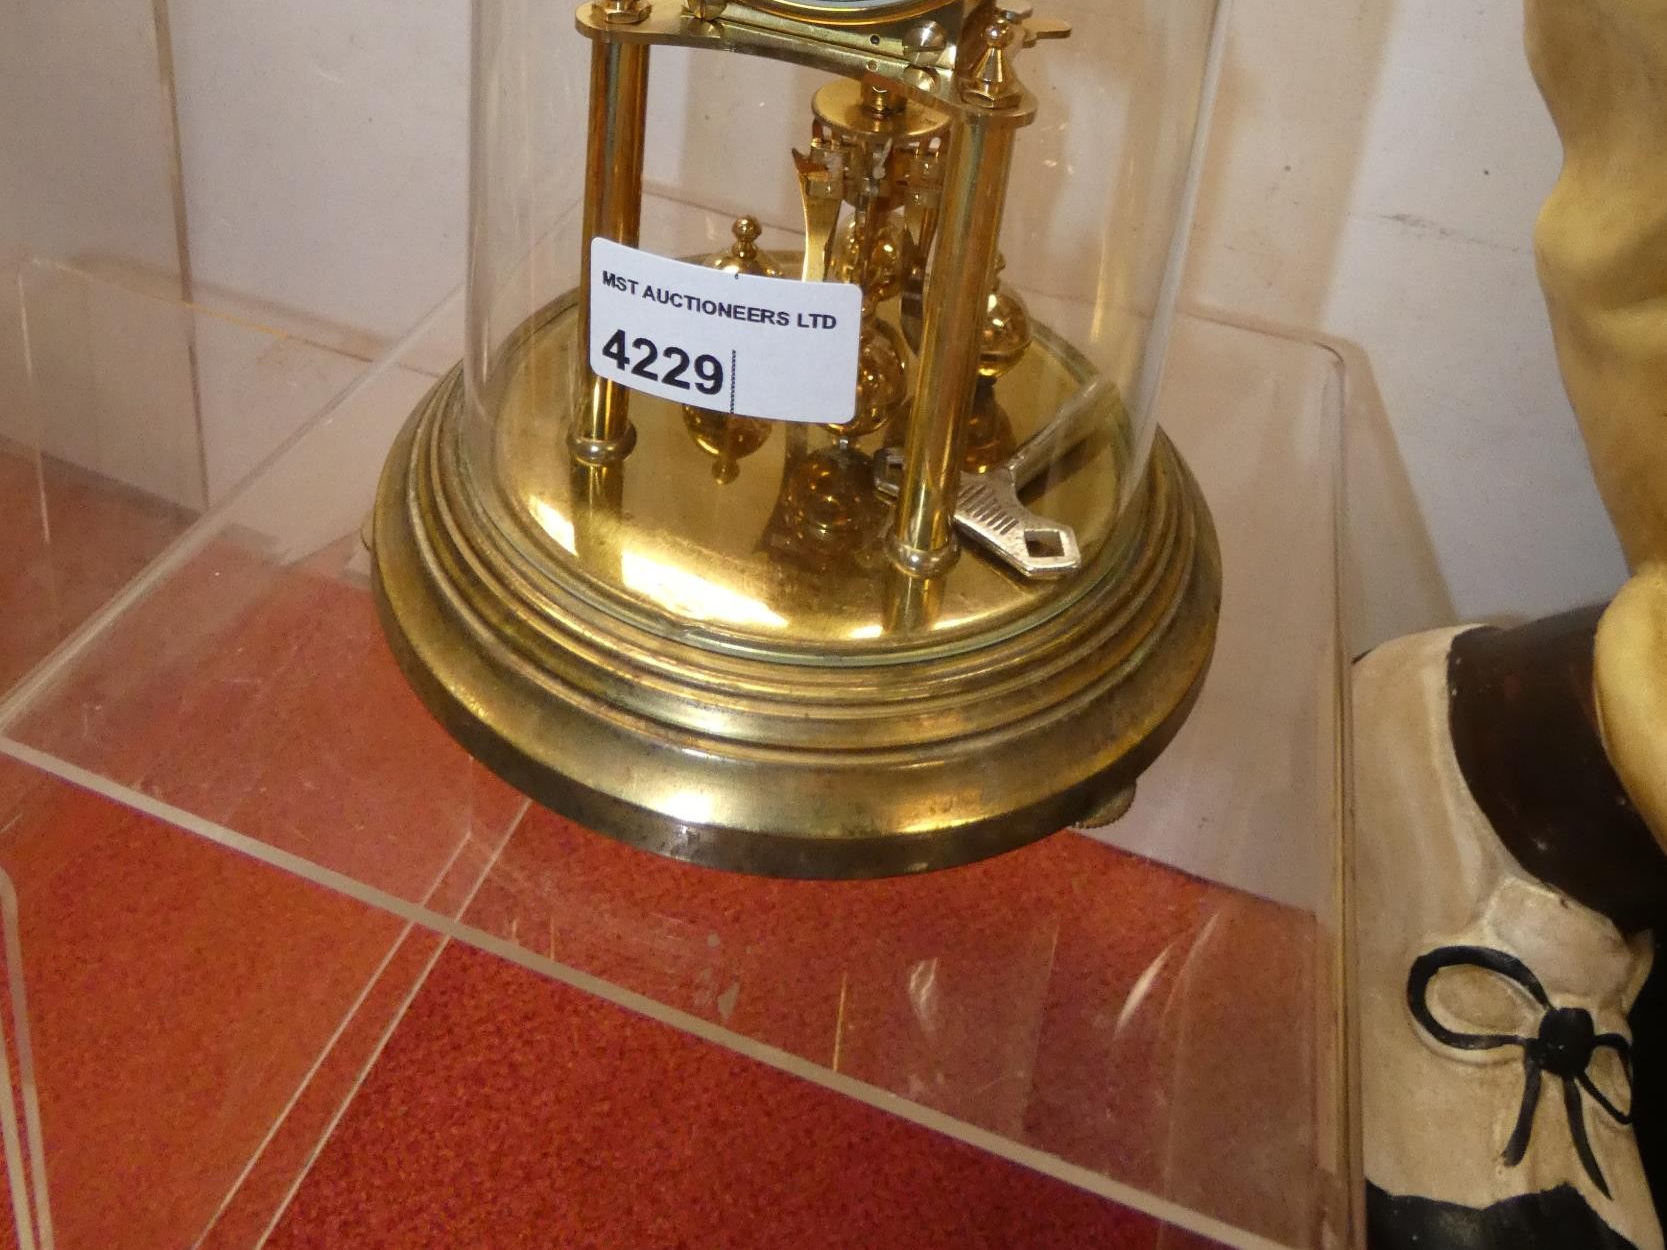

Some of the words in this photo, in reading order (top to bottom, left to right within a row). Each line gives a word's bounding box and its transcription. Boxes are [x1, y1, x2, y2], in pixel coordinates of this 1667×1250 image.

[602, 270, 639, 295] MST
[642, 284, 790, 327] AUCTIONEERS
[797, 312, 838, 330] LTD
[602, 328, 724, 396] 4229
